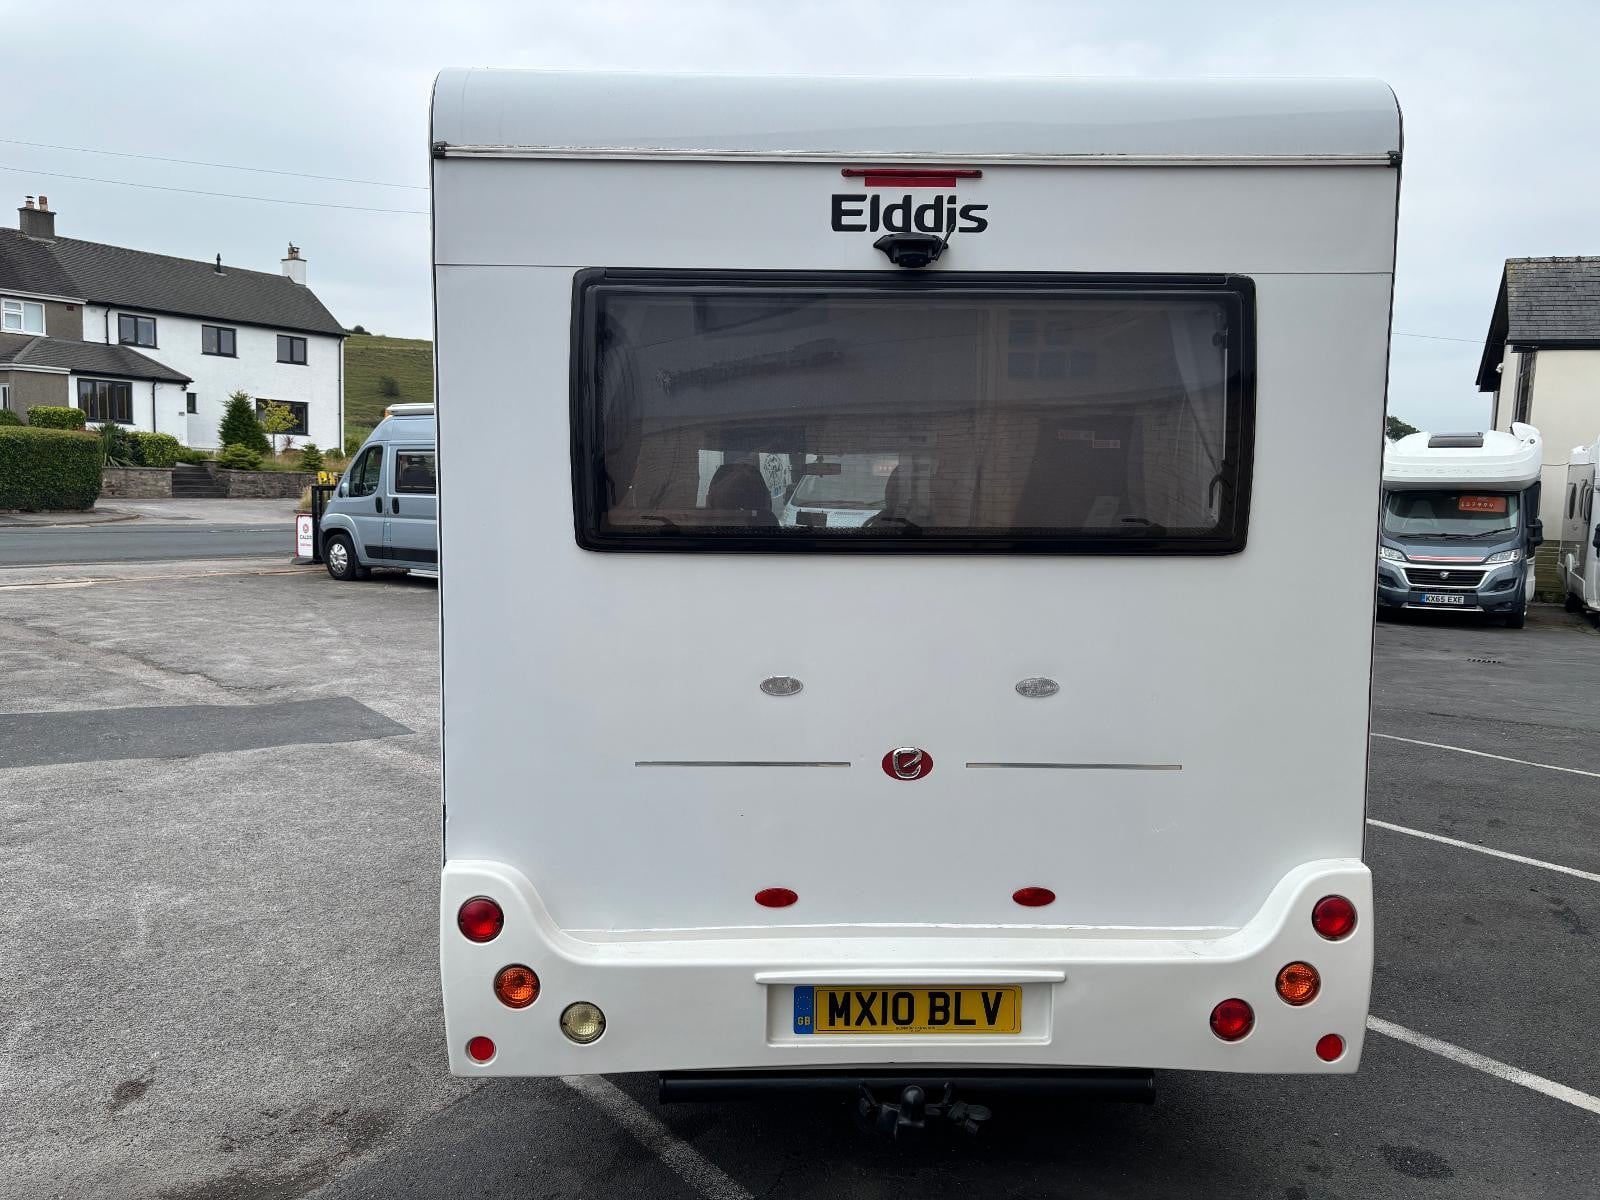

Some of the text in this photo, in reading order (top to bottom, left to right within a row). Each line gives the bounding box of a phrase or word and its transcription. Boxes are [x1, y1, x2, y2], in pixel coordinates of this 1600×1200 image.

[831, 193, 989, 233] Elddis
[797, 1016, 811, 1026] GB
[828, 991, 1004, 1026] MX10 BLV
